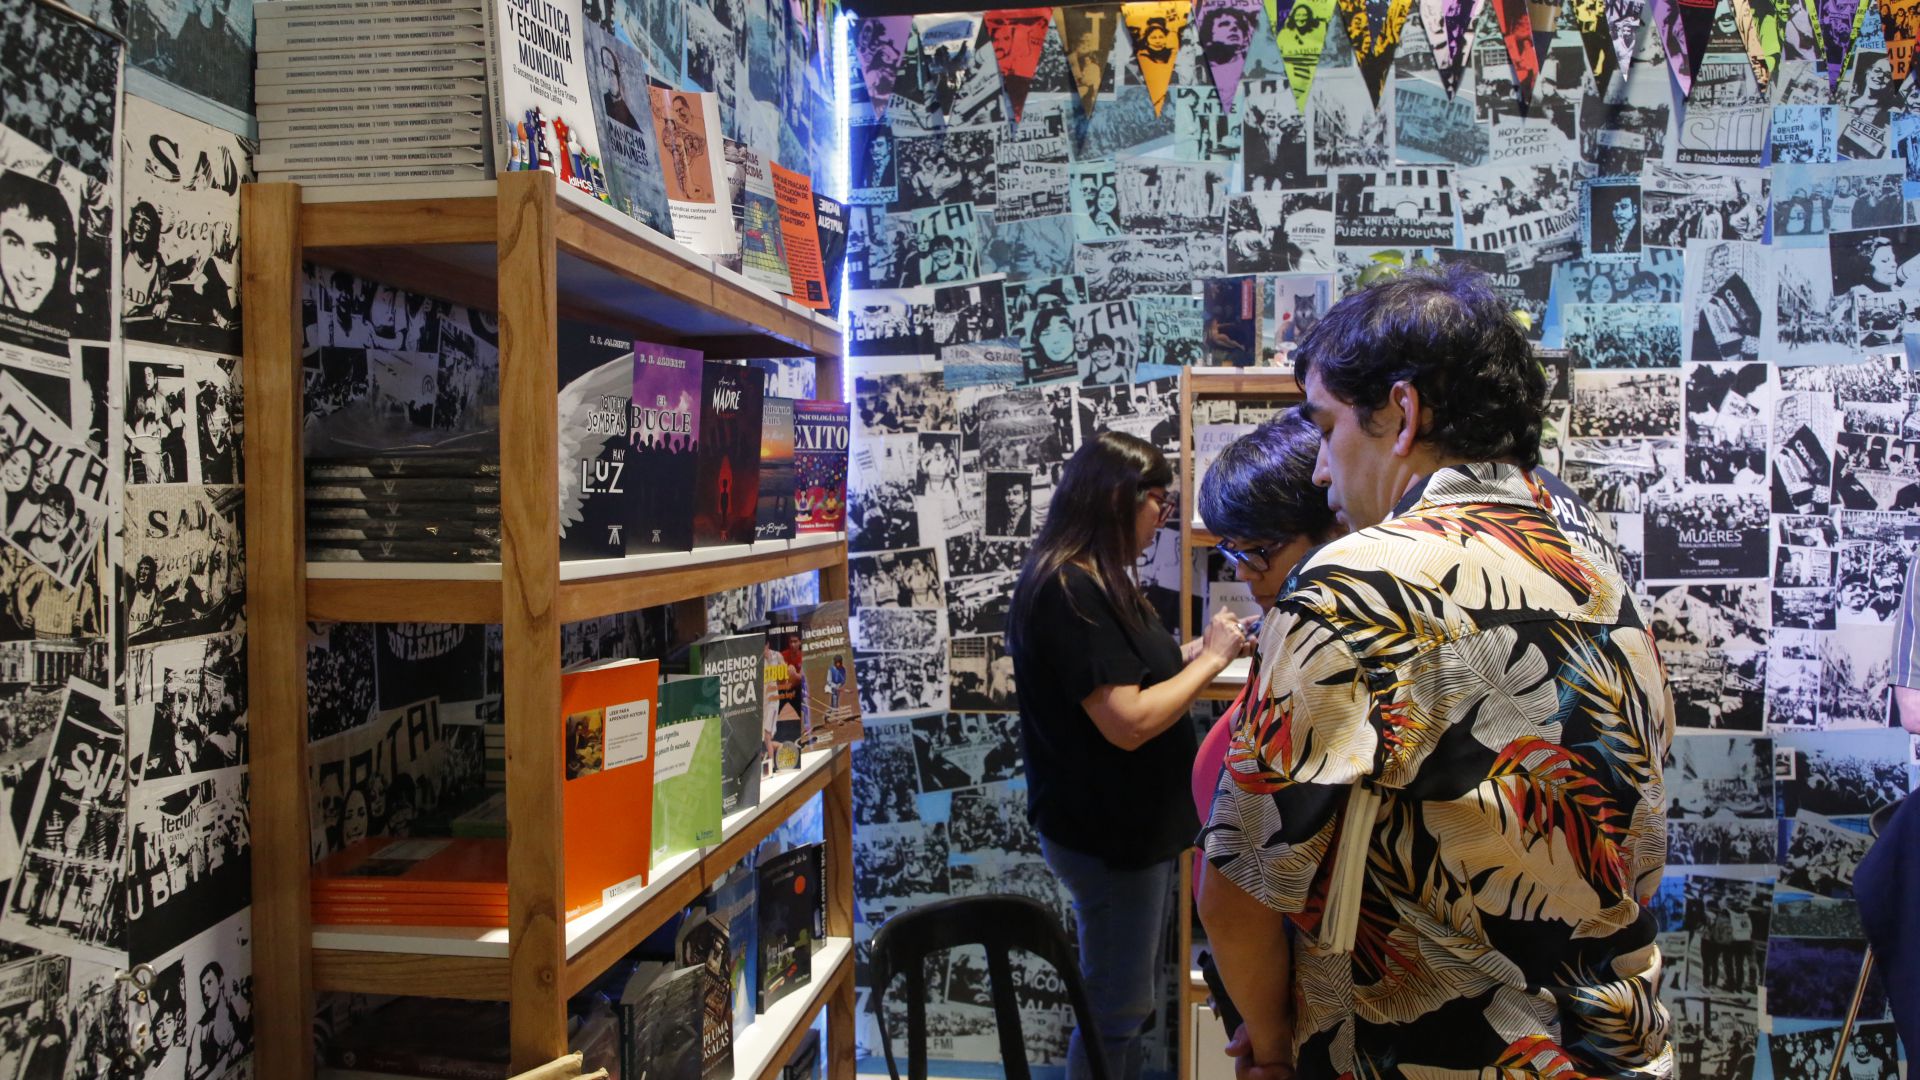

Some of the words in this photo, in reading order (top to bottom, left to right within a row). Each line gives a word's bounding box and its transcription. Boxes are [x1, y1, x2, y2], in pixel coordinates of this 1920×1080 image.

[507, 5, 514, 31] Y
[517, 11, 573, 64] ECONOMÍA
[518, 39, 568, 87] MUNDIAL
[1493, 144, 1562, 161] DOCENTS
[1678, 152, 1691, 162] de
[1694, 152, 1749, 165] trabajadores
[28, 319, 71, 338] Altamiranda
[712, 387, 741, 415] MADRE
[587, 410, 627, 437] SOMBRAS
[631, 404, 692, 433] BUCLE
[794, 421, 850, 451] ÉXITO
[612, 448, 625, 461] HAY
[582, 460, 624, 493] LUZ
[1679, 529, 1743, 543] MUJERES
[407, 624, 465, 661] LEALTAD
[802, 625, 843, 639] ucación
[809, 637, 845, 650] escolar
[704, 655, 757, 677] HACIENDO
[720, 667, 757, 685] CACIÓN
[720, 681, 757, 709] SICA
[704, 1020, 729, 1048] PLUMA
